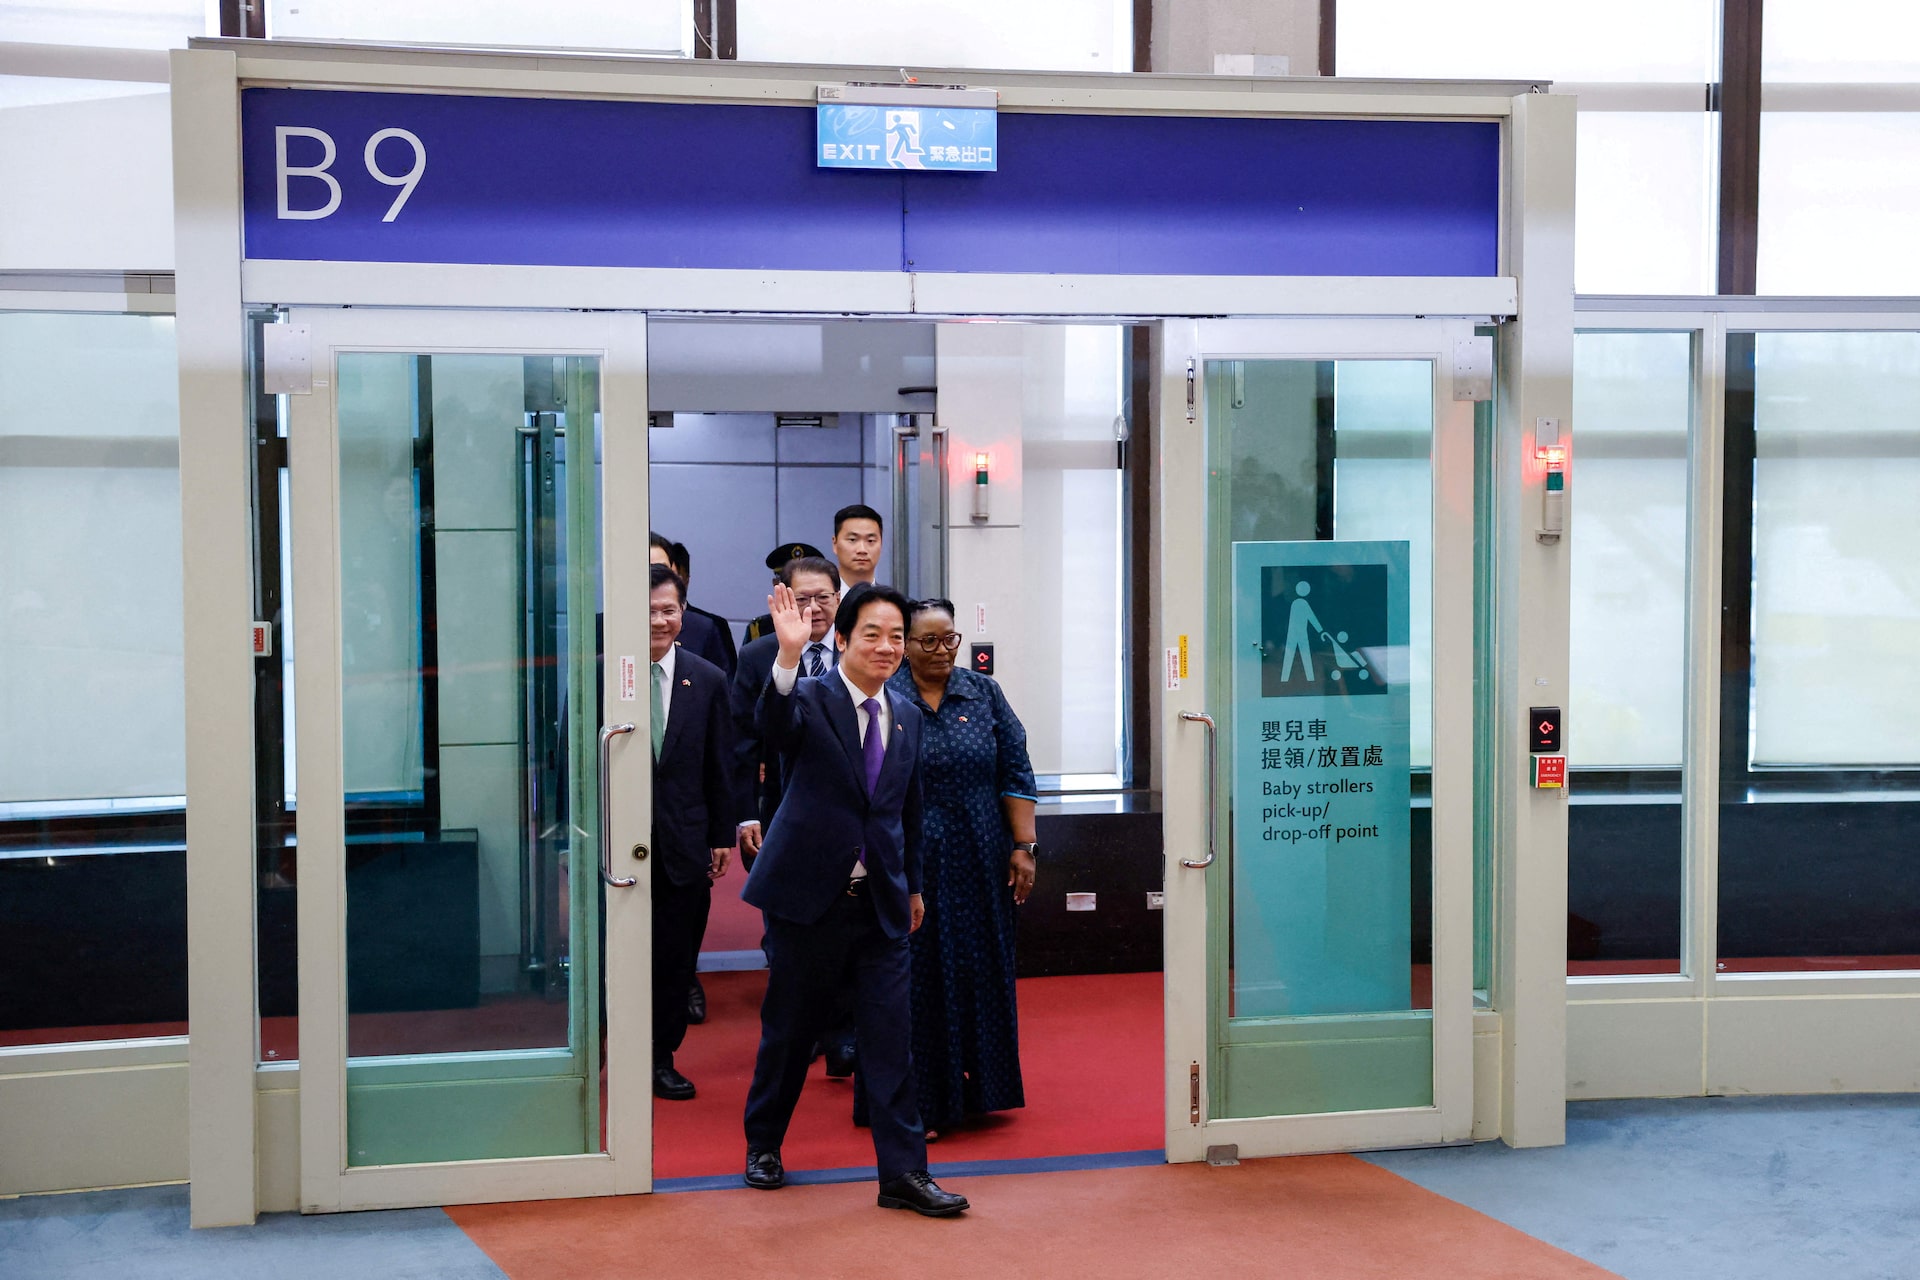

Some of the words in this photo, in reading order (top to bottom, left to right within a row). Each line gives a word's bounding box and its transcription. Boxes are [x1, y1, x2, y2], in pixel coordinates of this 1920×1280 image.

[823, 143, 881, 161] EXIT
[929, 145, 993, 164] 緊急出口
[1261, 718, 1328, 742] 嬰兒車
[1261, 744, 1384, 770] 提領/放置處
[1263, 780, 1302, 800] Baby
[1307, 778, 1374, 795] strollers
[1262, 801, 1330, 823] pick-up/
[1262, 824, 1332, 845] drop-off
[1336, 823, 1379, 844] point
